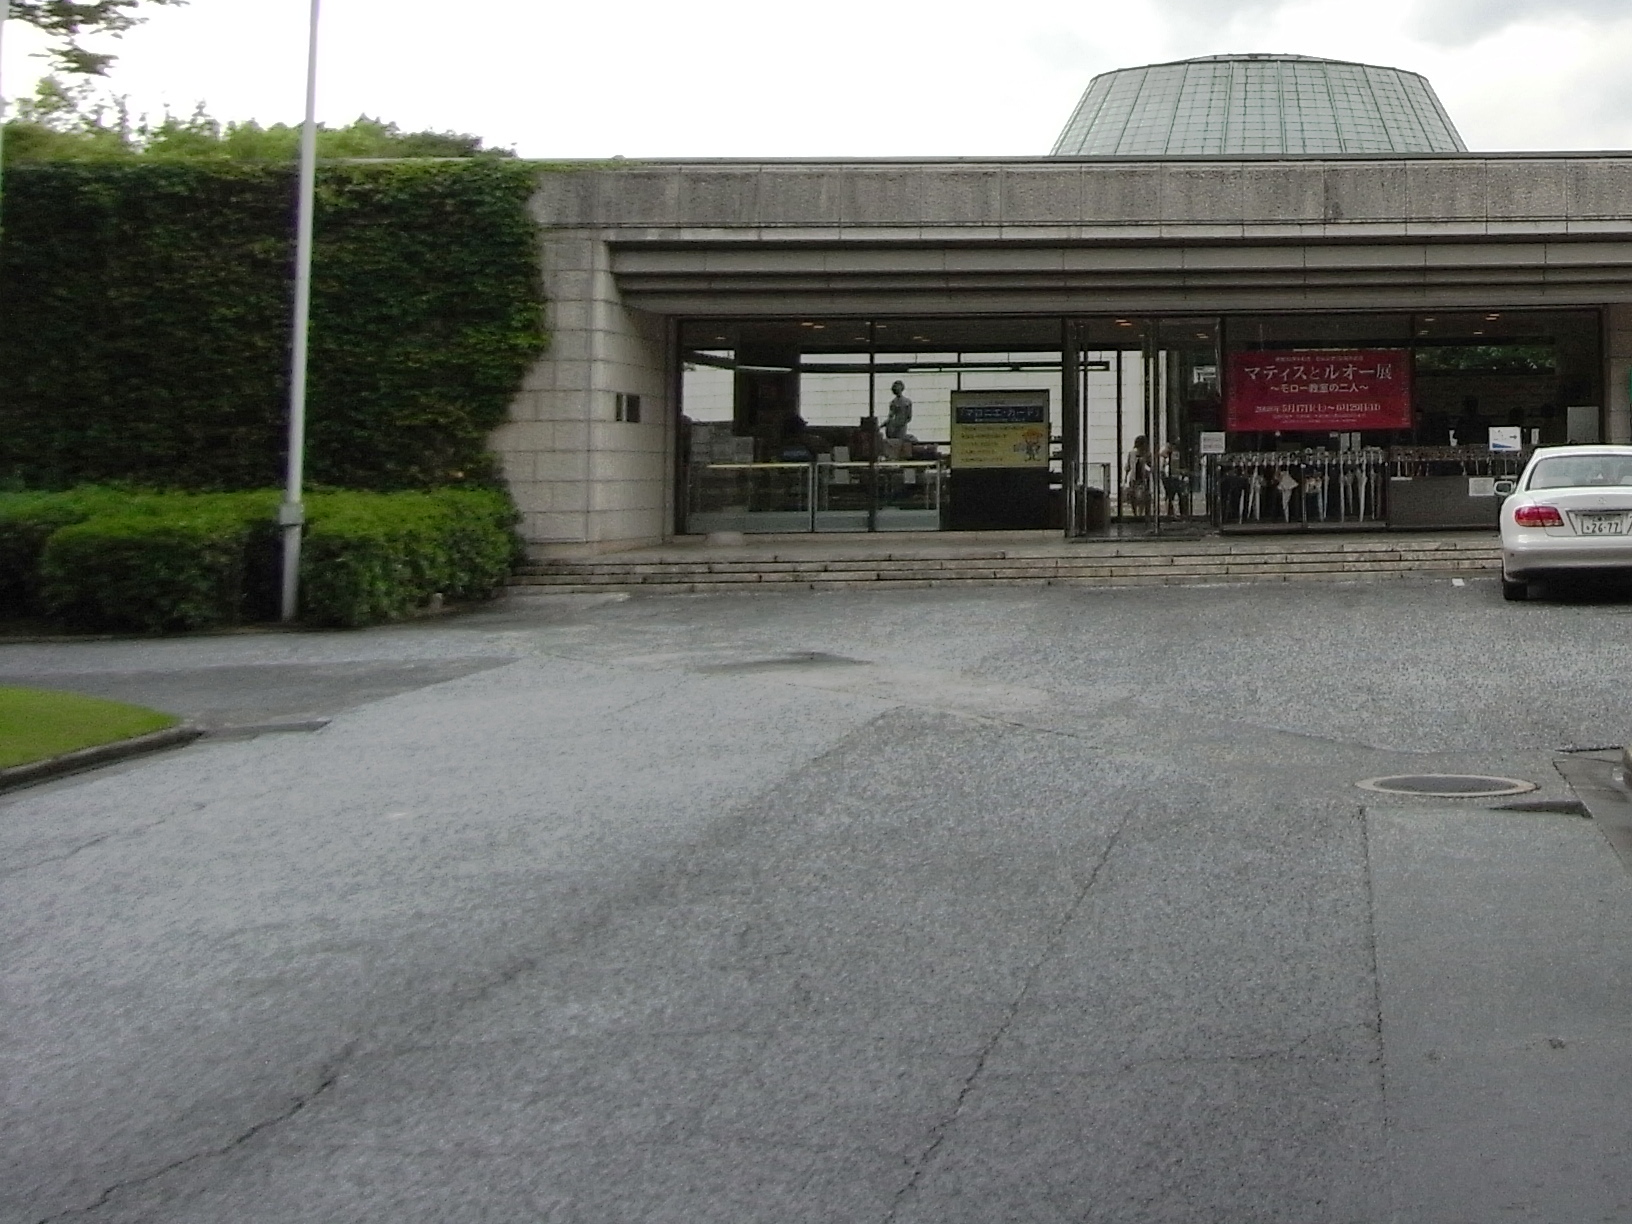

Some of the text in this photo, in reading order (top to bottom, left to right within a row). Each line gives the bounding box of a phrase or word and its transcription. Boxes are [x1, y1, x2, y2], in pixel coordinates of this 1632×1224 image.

[1244, 363, 1393, 381] マティスとルオー展
